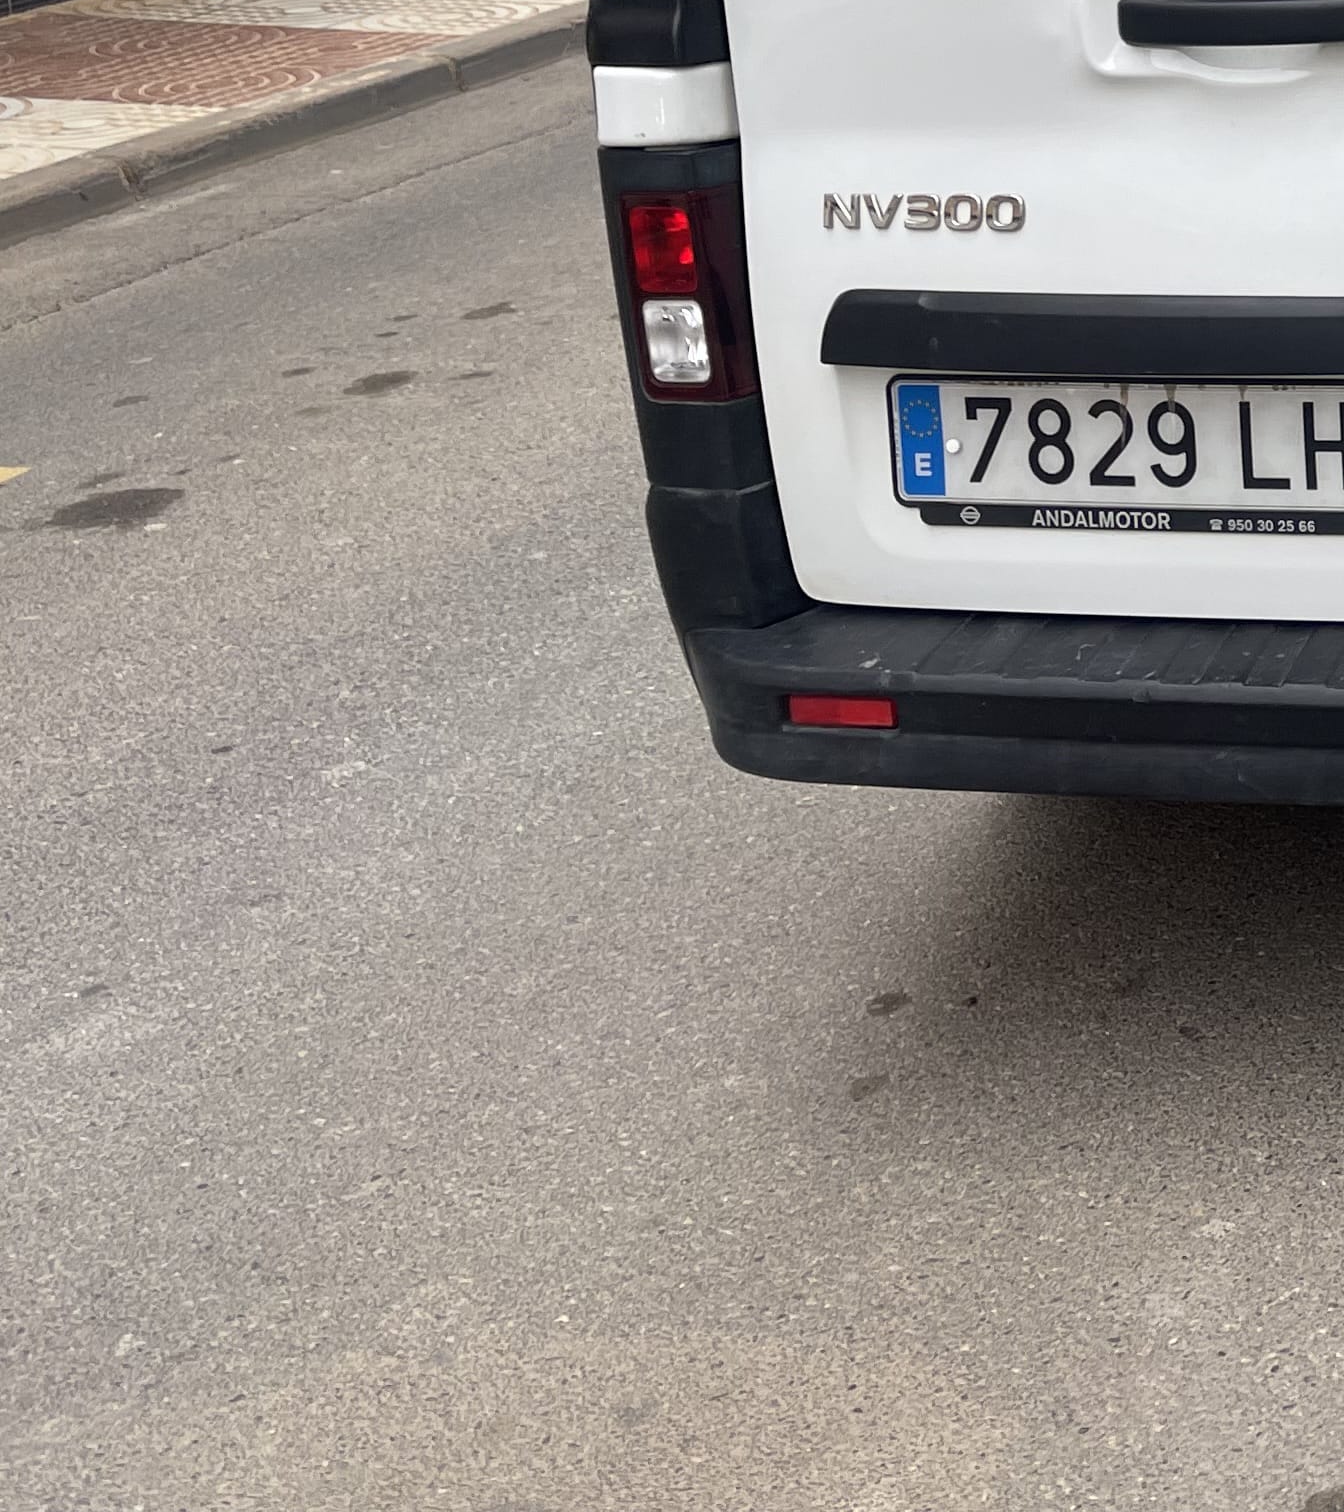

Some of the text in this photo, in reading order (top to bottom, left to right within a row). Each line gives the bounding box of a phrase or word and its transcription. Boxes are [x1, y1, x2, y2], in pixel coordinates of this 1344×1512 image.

[824, 193, 1026, 234] NV300
[964, 395, 1197, 488] 7829
[914, 452, 933, 477] E
[1031, 509, 1316, 533] ANDALMOTOR 950 30 25 66
